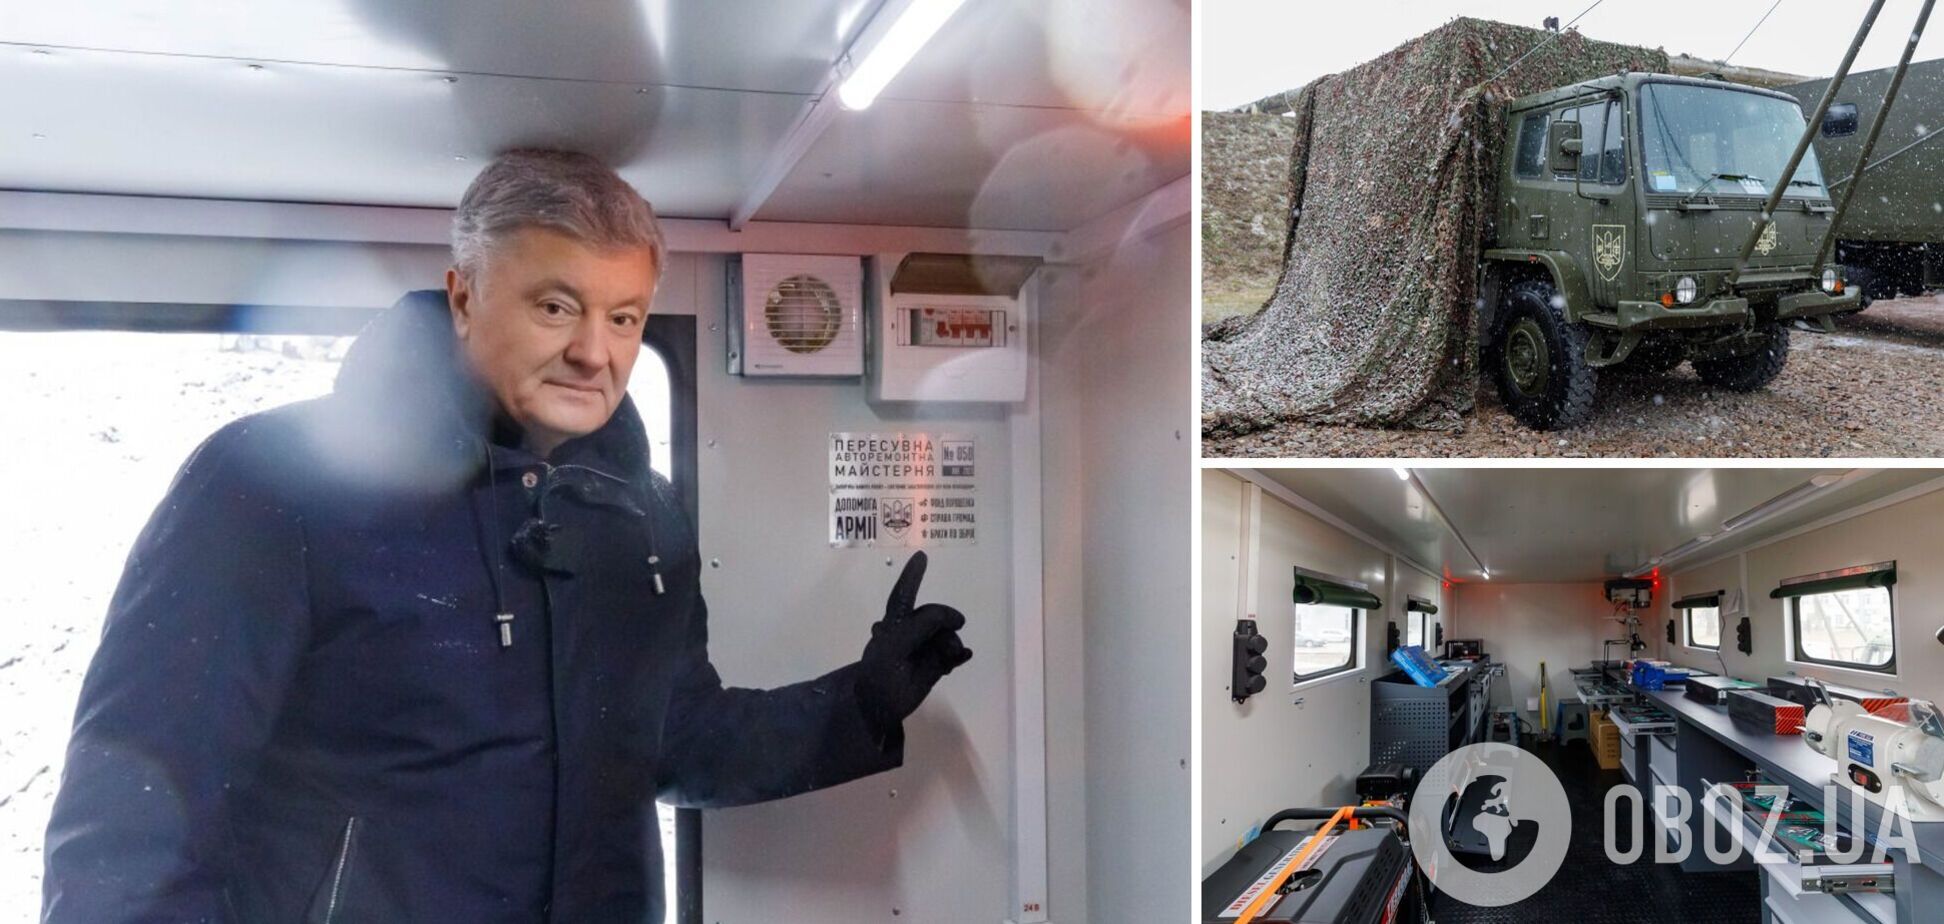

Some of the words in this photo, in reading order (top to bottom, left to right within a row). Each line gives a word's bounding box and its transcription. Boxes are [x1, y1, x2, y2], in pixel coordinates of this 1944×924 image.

[835, 440, 933, 452] ПЕРЕСУВНА
[835, 453, 935, 461] АВТОРЕМОНТНА
[835, 463, 935, 477] МАЙСТЕРНЯ
[835, 497, 877, 512] ДОПОМОГА
[836, 513, 877, 540] АРМІЇ
[1229, 881, 1266, 911] DIESEL
